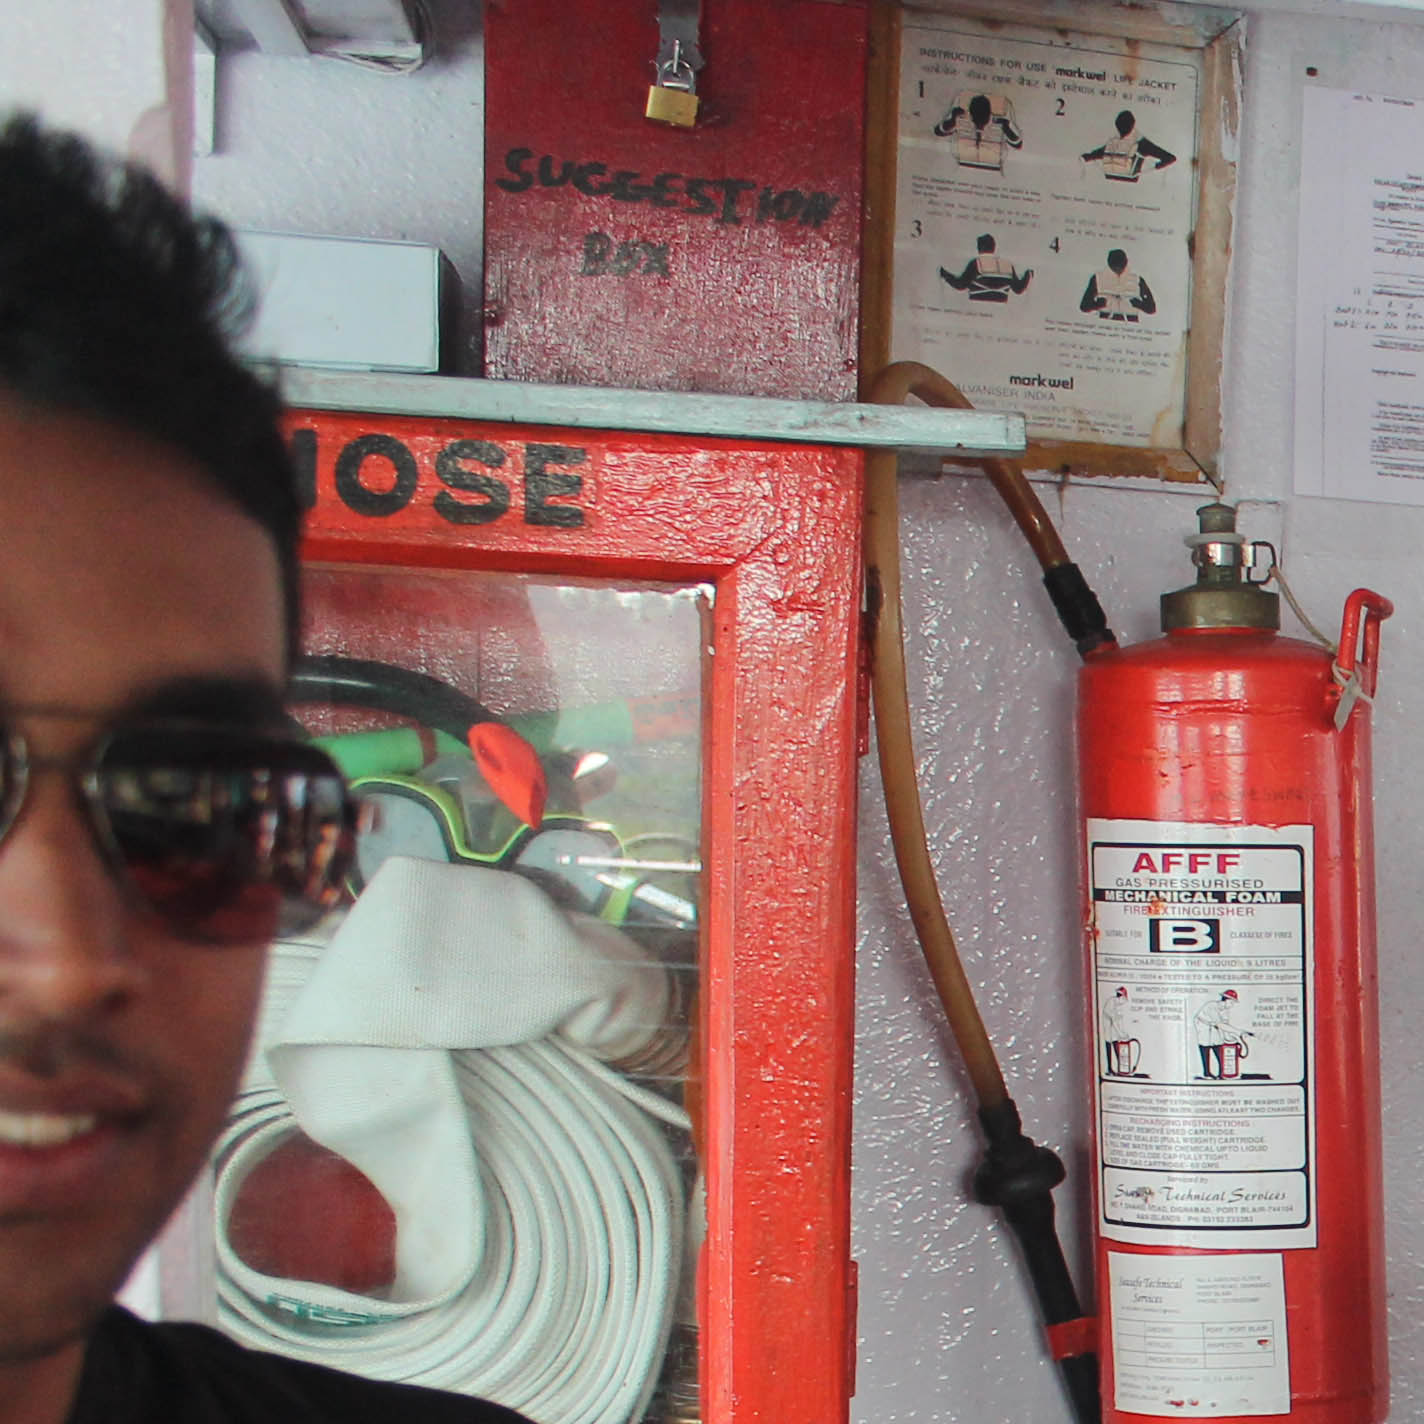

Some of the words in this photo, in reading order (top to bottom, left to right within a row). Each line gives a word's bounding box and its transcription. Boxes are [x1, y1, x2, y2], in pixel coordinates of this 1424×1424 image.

[919, 47, 994, 67] INSTRUCTIONS
[1000, 58, 1021, 70] FOR
[1026, 61, 1048, 73] USE
[1139, 79, 1177, 92] JACKET
[918, 81, 924, 98] 1
[1055, 98, 1066, 116] 2
[911, 219, 923, 239] 3
[1048, 236, 1061, 254] 4
[1009, 373, 1074, 391] markwel
[1024, 390, 1056, 401] INDIA
[1132, 852, 1241, 874] AFFF
[1115, 877, 1143, 889] GAS
[1148, 878, 1264, 890] PRESSURISED
[1104, 890, 1219, 903] MECHANICAL
[1226, 891, 1281, 904] FOAM
[1123, 904, 1150, 916] FIRE
[1159, 919, 1213, 952] B
[1160, 1186, 1226, 1202] Technical
[1227, 1188, 1287, 1204] Services
